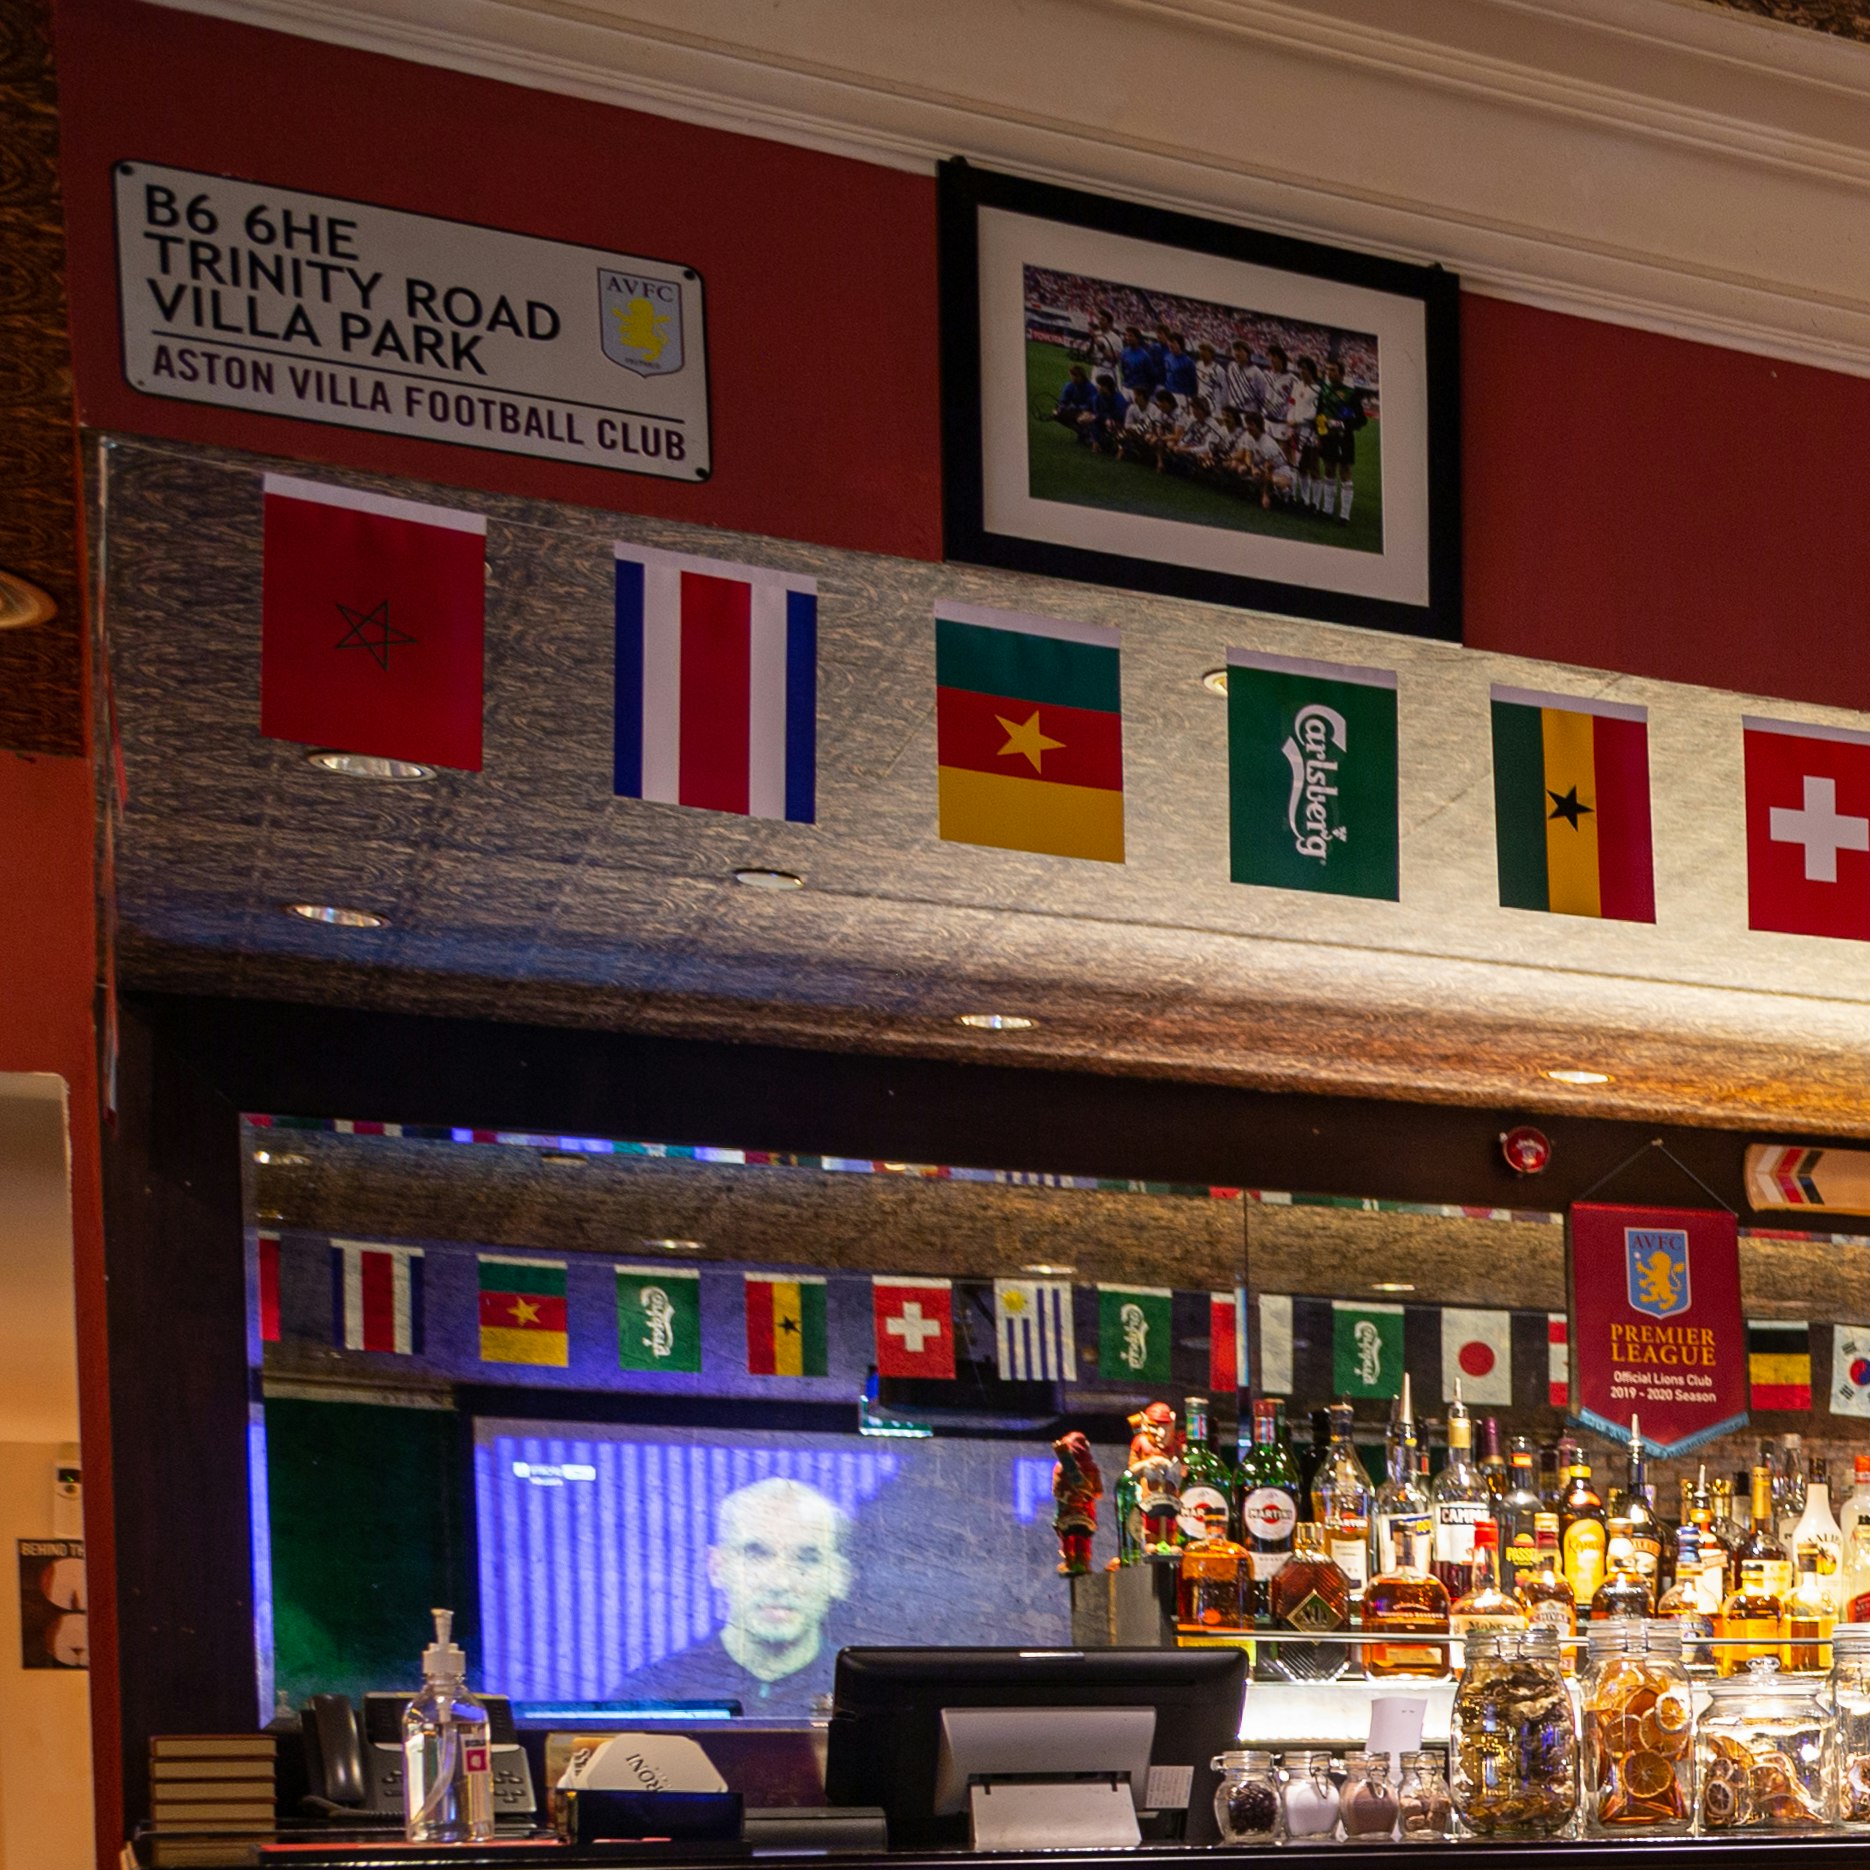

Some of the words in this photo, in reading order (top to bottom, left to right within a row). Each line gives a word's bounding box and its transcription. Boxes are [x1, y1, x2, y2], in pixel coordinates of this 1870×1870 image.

[144, 184, 219, 234] B6
[245, 204, 359, 260] 6HE
[142, 232, 383, 310] TRINITY
[406, 279, 561, 341] ROAD
[607, 276, 674, 303] AVFC
[147, 279, 321, 346] VILLA
[341, 314, 488, 375] PARK
[152, 344, 274, 395] ASTON
[291, 366, 391, 414] VILLA
[405, 382, 584, 444] FOOTBALL
[597, 419, 686, 460] CLUB
[1281, 704, 1347, 866] Carlsberg
[1632, 1234, 1682, 1251] AVFC
[1610, 1323, 1715, 1346] PREMIER
[1611, 1343, 1716, 1366] LEAGUE
[1613, 1370, 1651, 1384] Official
[1654, 1372, 1685, 1386] Lions
[1686, 1373, 1713, 1387] Club
[1610, 1386, 1637, 1399] 2019
[1647, 1388, 1673, 1401] 2020
[1675, 1389, 1717, 1403] Season
[1248, 1508, 1292, 1520] MARTINI
[20, 1542, 68, 1557] BEHIND
